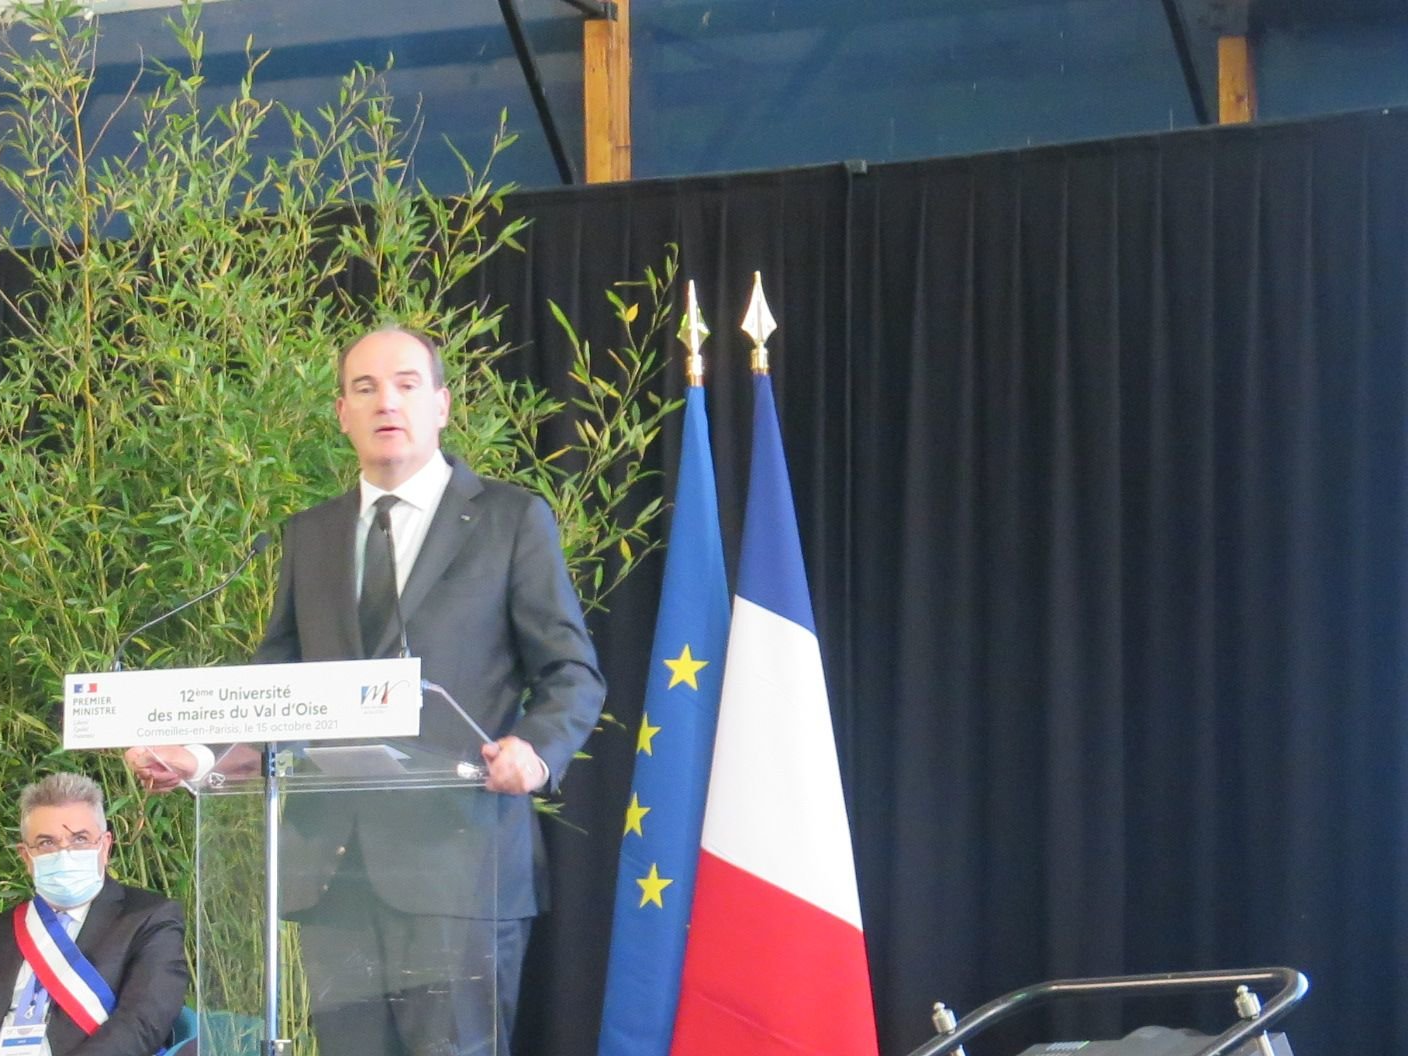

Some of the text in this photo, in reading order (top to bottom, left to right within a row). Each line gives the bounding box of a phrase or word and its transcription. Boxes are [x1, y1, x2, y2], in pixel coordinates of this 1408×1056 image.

[72, 696, 113, 706] PREMIER
[179, 684, 292, 703] 12ème Université
[72, 706, 117, 716] MINISTRE
[147, 701, 329, 722] des maires du Val d'Oise
[244, 721, 254, 733] le
[256, 721, 269, 733] 15
[270, 719, 312, 732] octobre
[314, 718, 339, 731] 2021
